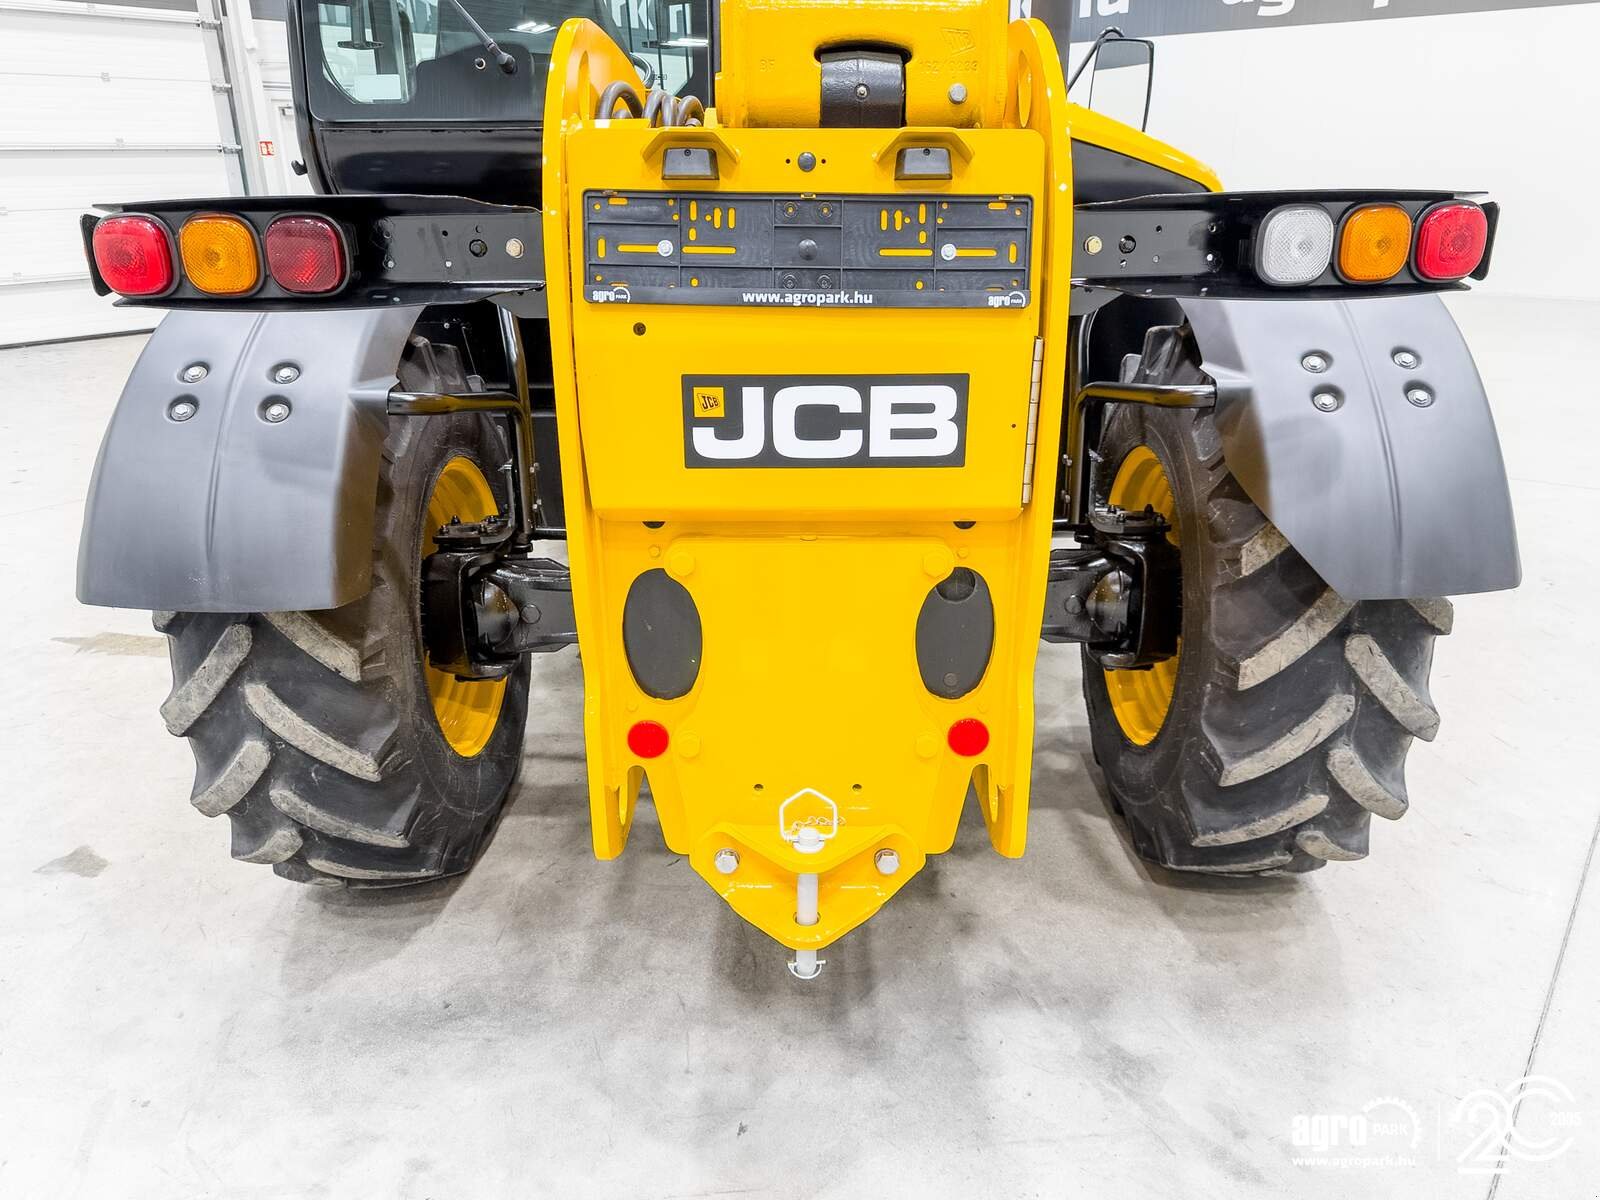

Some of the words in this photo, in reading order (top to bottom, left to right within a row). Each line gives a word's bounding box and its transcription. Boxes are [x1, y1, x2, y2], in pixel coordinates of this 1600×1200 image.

[592, 290, 615, 303] agro
[742, 290, 873, 306] www.agropark.hu
[988, 295, 1010, 307] agro
[701, 395, 719, 410] JCB
[692, 385, 959, 459] JCB
